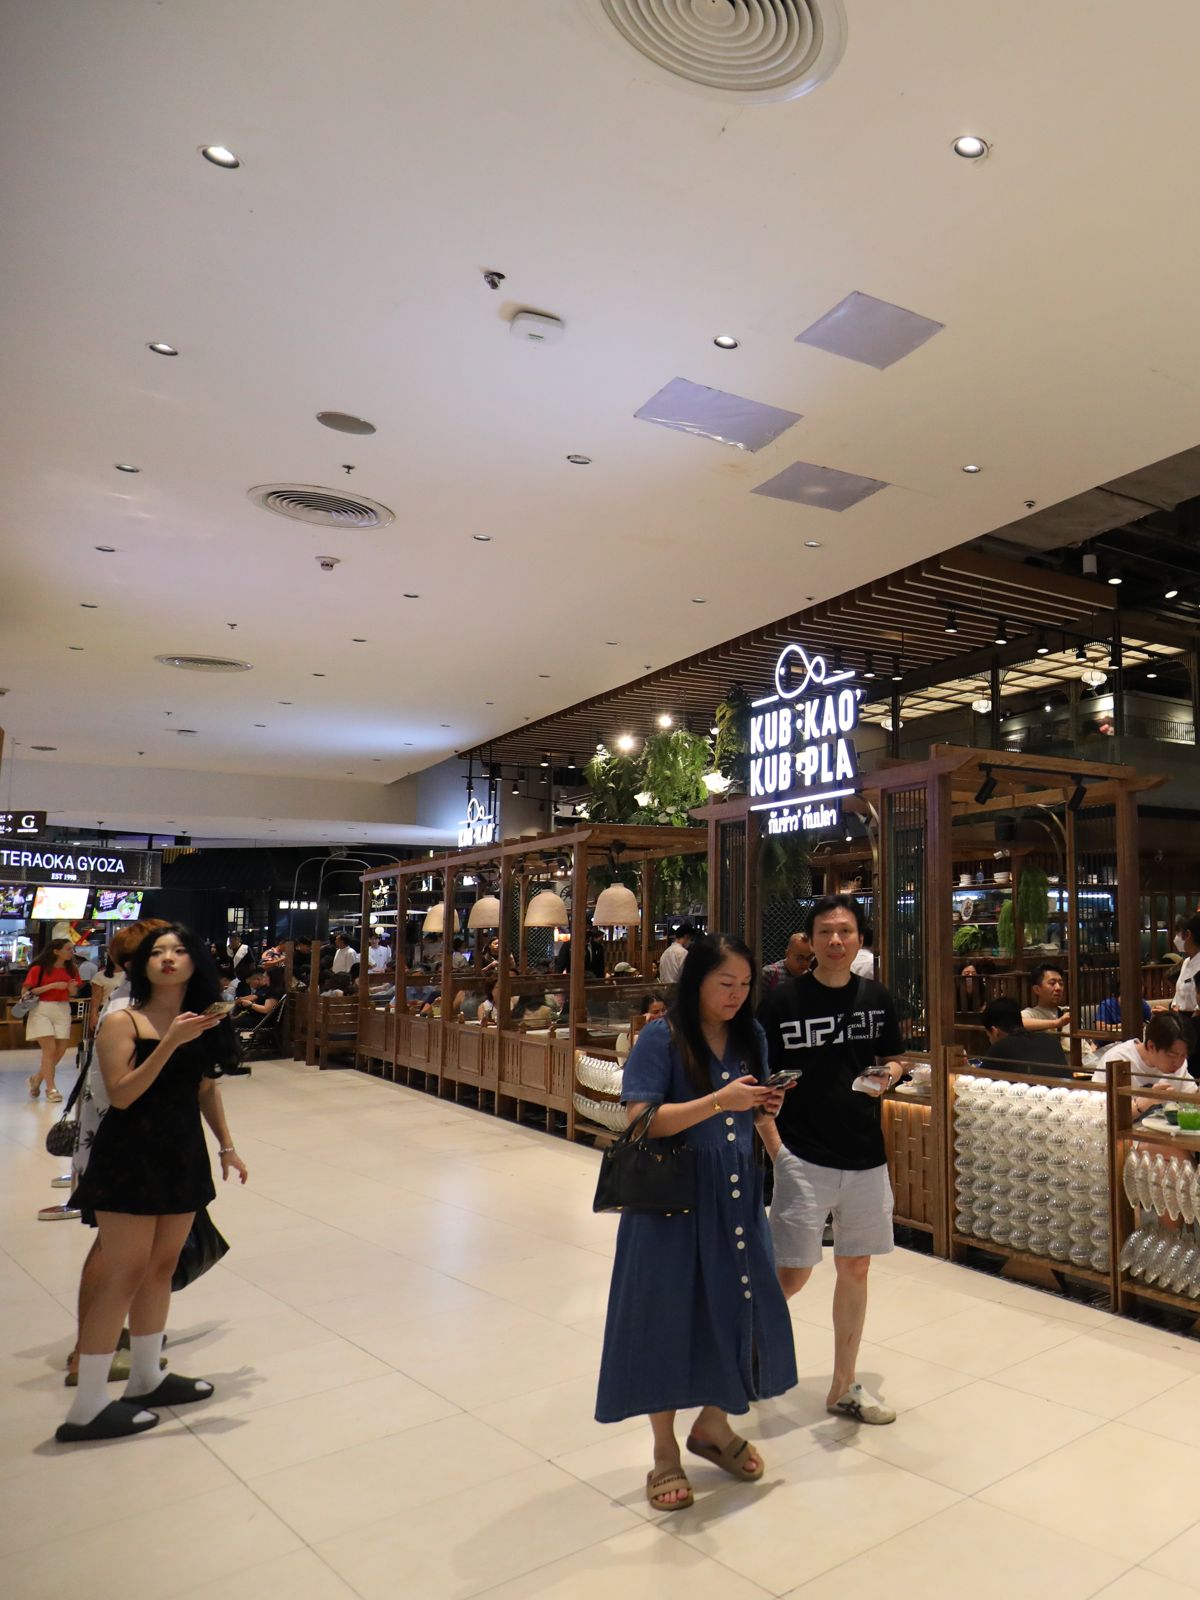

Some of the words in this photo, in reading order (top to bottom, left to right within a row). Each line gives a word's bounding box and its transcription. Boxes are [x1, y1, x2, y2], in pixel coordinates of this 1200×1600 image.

[750, 707, 792, 754] KUB
[750, 751, 792, 797] KUB
[804, 738, 854, 787] PLA
[21, 814, 36, 828] G
[2, 850, 75, 870] TERAOKA
[77, 855, 125, 873] GYOZA
[51, 872, 63, 880] EST
